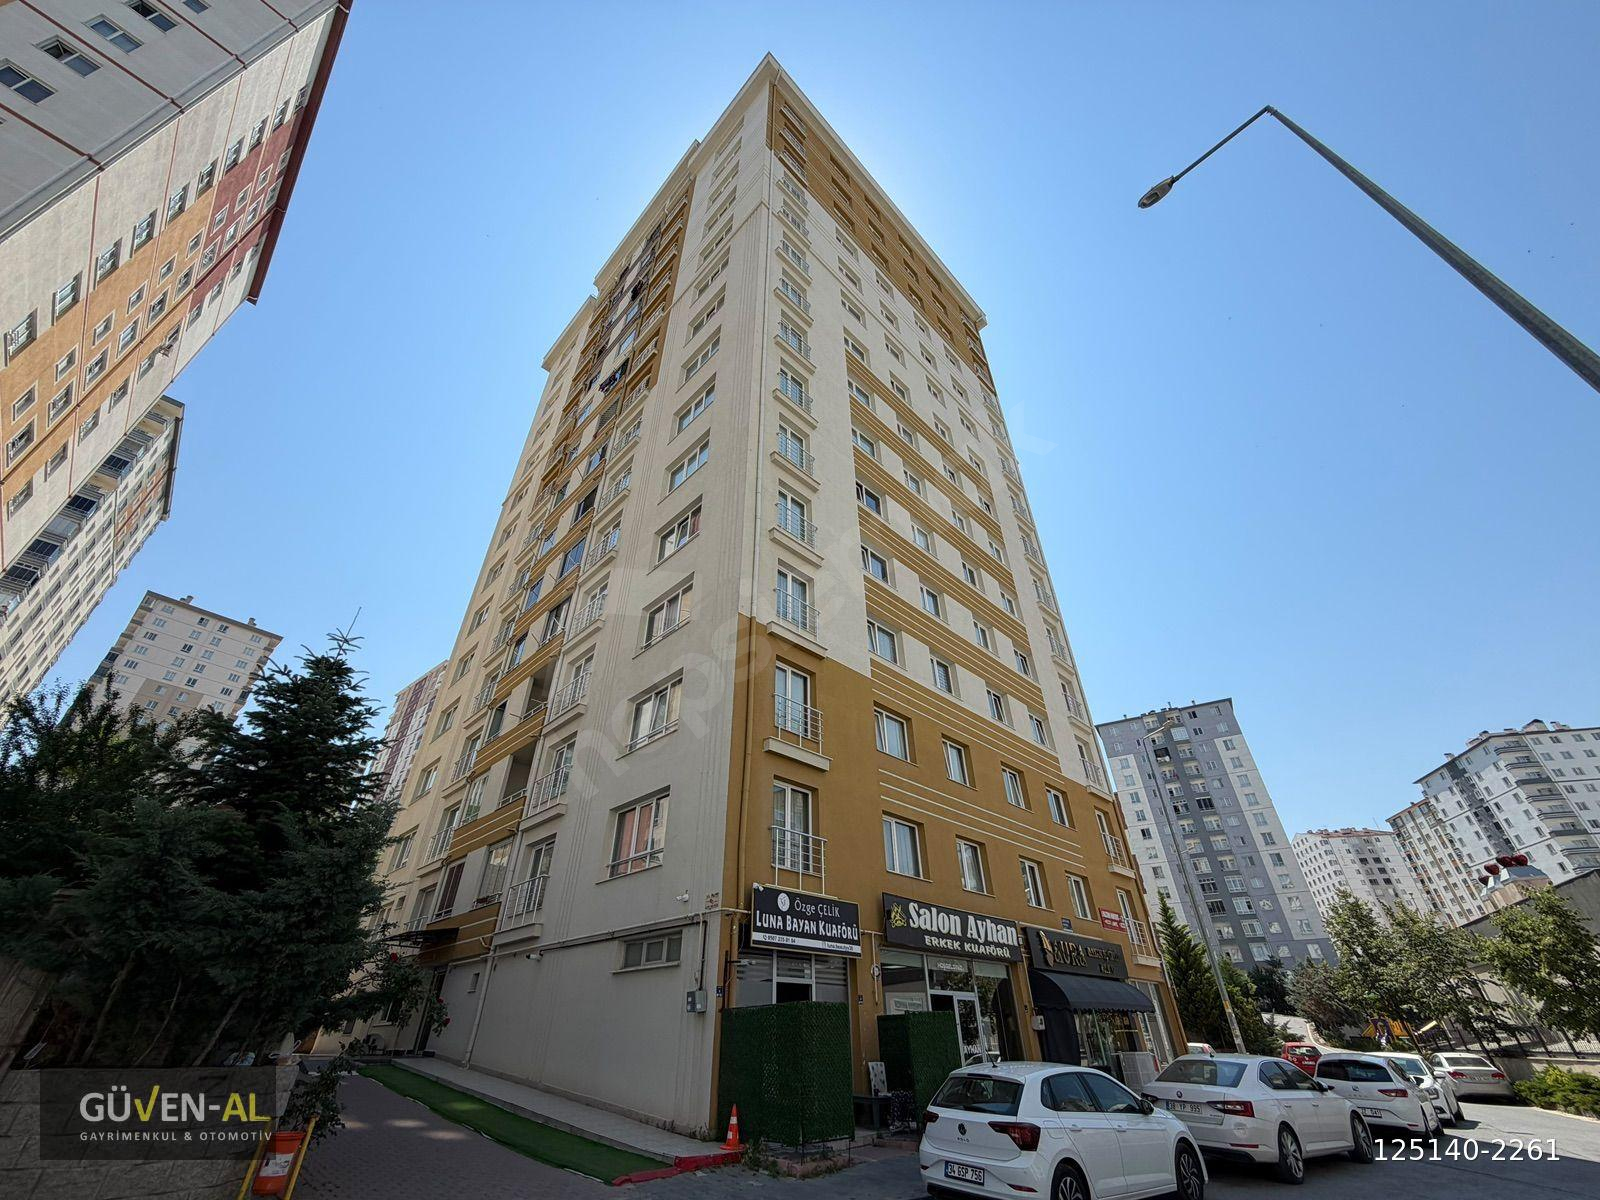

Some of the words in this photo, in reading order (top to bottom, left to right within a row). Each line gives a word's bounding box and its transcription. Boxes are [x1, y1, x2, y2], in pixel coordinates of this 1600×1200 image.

[794, 898, 815, 915] Özge
[818, 904, 840, 918] ÇELİK
[756, 910, 783, 929] LUNA
[786, 915, 816, 934] BAYAN
[819, 920, 858, 940] KUAFÖRÜ
[908, 902, 962, 936] Salon
[967, 915, 1018, 946] Ayhan
[924, 935, 961, 951] ERKEK
[964, 942, 1011, 958] KUAFÖRÜ
[948, 1164, 956, 1175] 34
[958, 1166, 968, 1178] GSP
